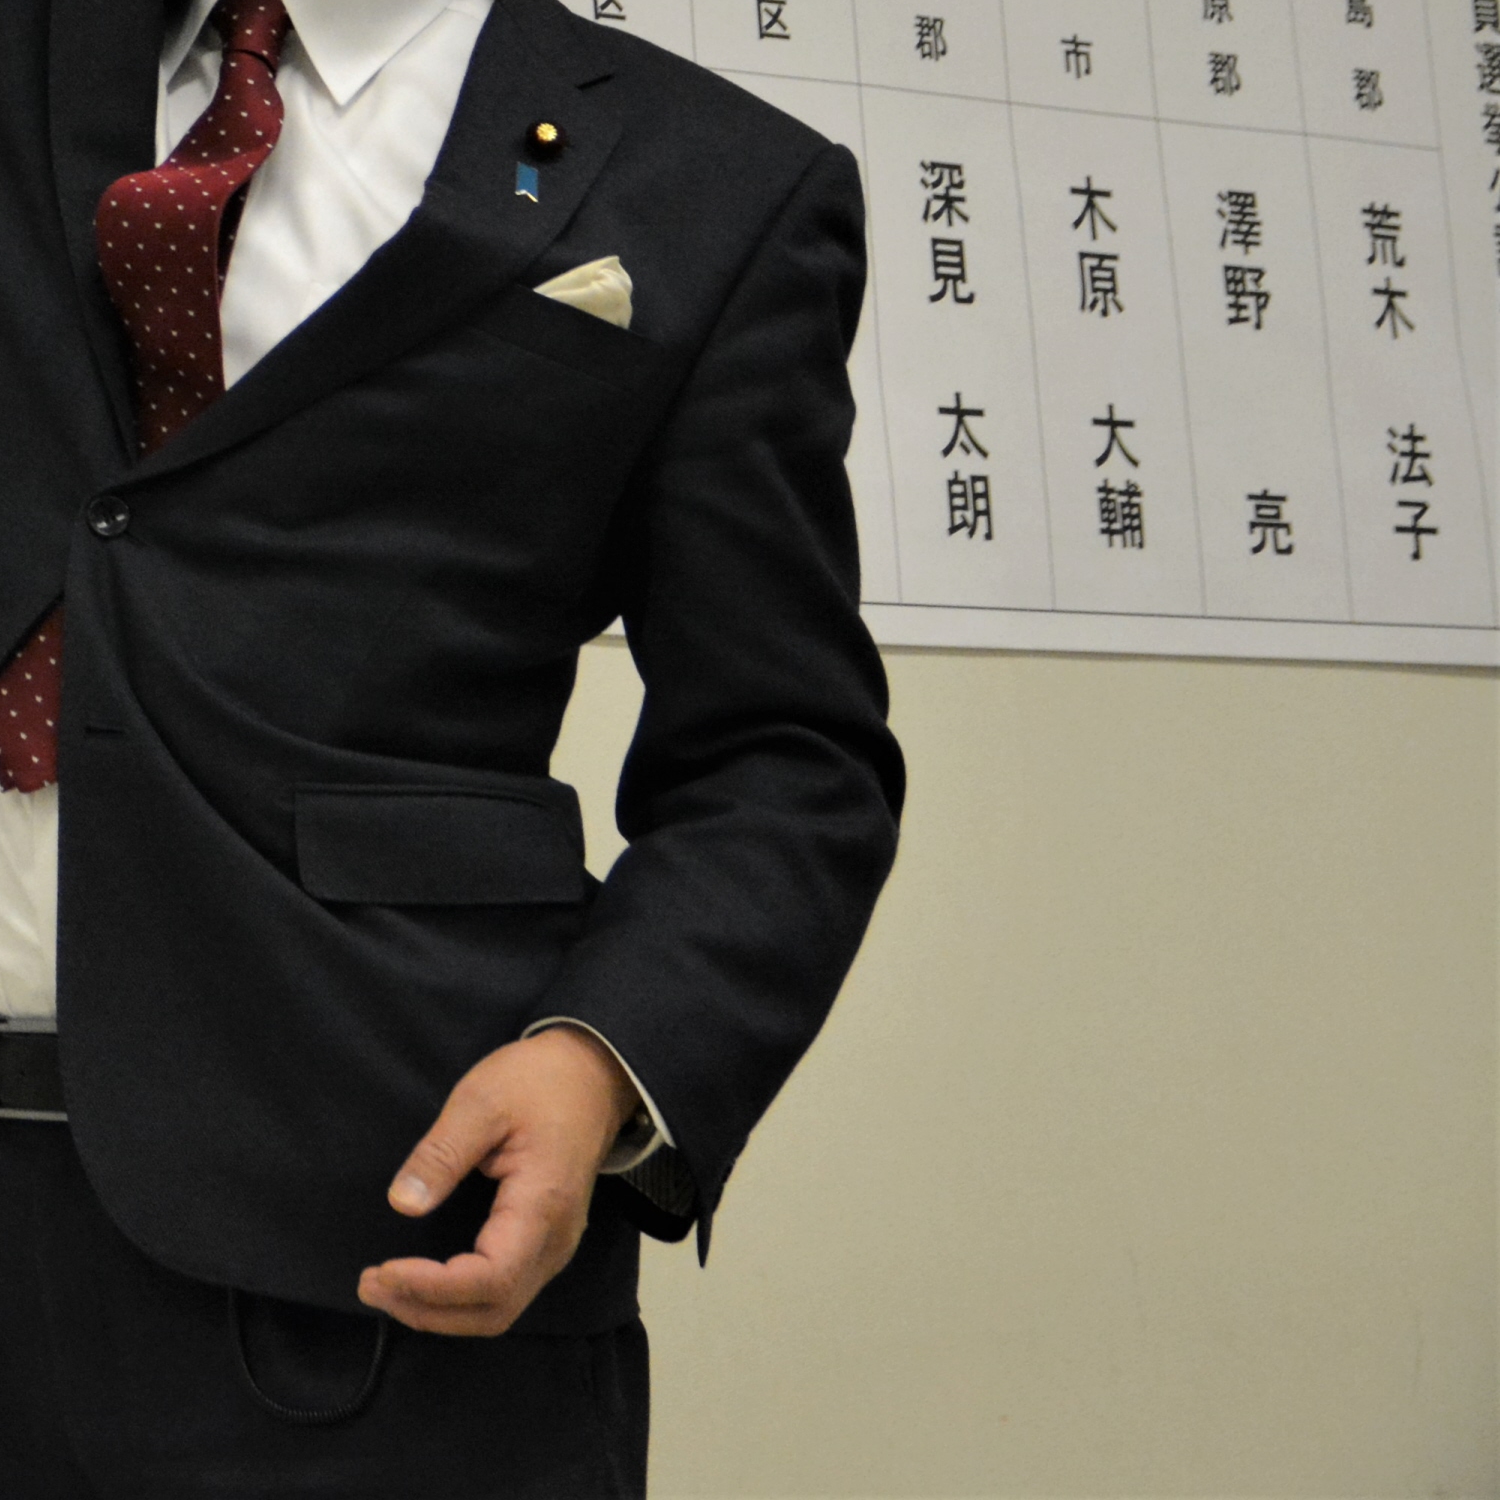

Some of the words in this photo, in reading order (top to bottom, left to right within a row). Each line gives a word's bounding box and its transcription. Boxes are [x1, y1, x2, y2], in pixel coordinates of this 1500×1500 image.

[921, 161, 974, 304] 深見
[1070, 177, 1123, 317] 木原
[1218, 191, 1270, 330] 澤野
[1247, 490, 1293, 555] 亮
[1362, 204, 1413, 337] 荒木
[1388, 424, 1438, 560] 法子
[939, 392, 992, 540] 太朗
[1093, 405, 1144, 549] 大輔
